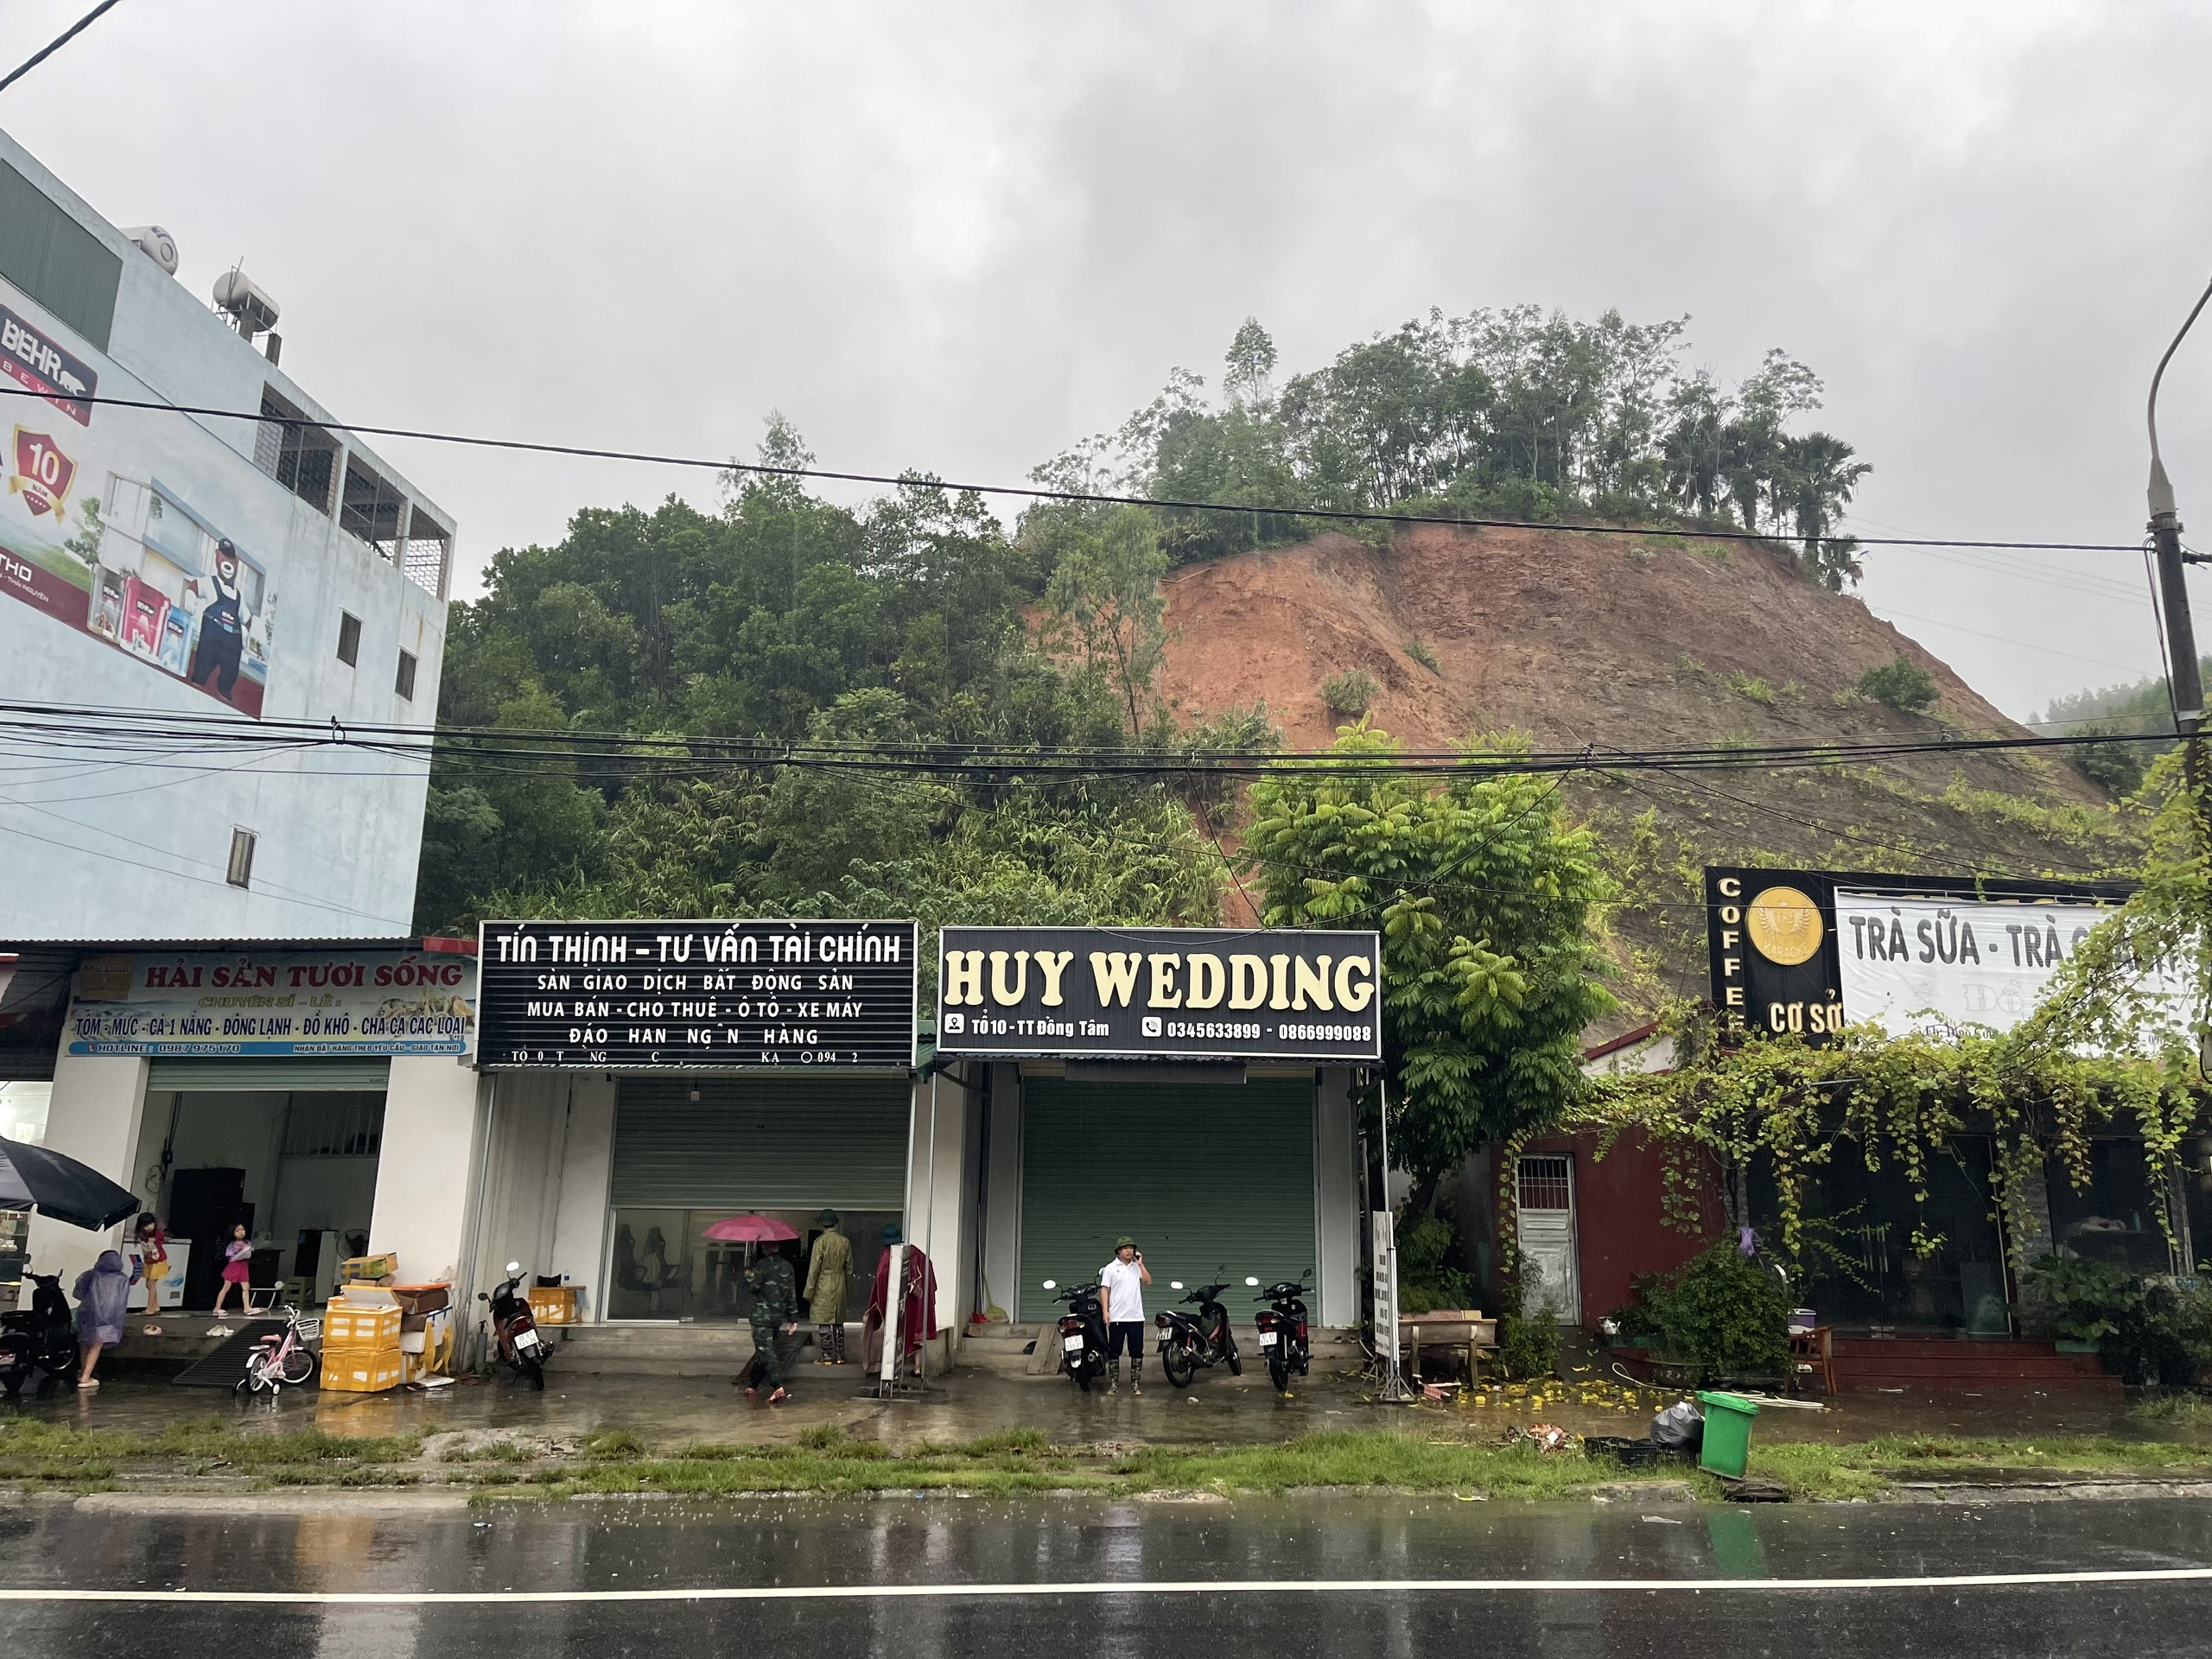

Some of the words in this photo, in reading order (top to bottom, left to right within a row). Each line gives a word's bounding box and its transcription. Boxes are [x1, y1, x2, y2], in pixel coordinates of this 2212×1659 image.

[1, 318, 61, 383] BEHR
[29, 442, 60, 486] 10
[497, 924, 537, 963] TÍN
[549, 931, 627, 967] THỊNH
[657, 934, 693, 963] TƯ
[703, 923, 758, 963] VẤN
[769, 923, 810, 963] TÀI
[819, 923, 900, 963] CHÍNH
[1764, 940, 1810, 958] KARAOKE
[1849, 906, 1910, 963] TRÀ
[1917, 908, 1980, 965] SỮA
[2005, 913, 2065, 969] TRÀ
[145, 957, 203, 988] HẢI
[212, 957, 278, 988] SẢN
[287, 962, 365, 987] TƯƠI
[374, 955, 463, 987] SỐNG
[537, 967, 570, 990] SÀN
[583, 968, 627, 990] GIAO
[643, 968, 687, 995] DỊCH
[703, 968, 735, 990] BẤT
[752, 968, 802, 995] ĐỘNG
[818, 967, 853, 990] SẢN
[944, 950, 1074, 1007] HUY
[1089, 951, 1376, 1012] WEDDING
[198, 995, 274, 1008] CHUYÊN
[527, 1001, 565, 1017] MUA
[575, 995, 609, 1017] BÁN
[626, 1002, 664, 1018] CHO
[671, 995, 717, 1018] THUÊ
[738, 995, 750, 1018] Ô
[757, 995, 779, 1018] TÔ
[798, 1002, 819, 1018] XE
[826, 995, 862, 1018] MÁY
[1768, 1000, 1803, 1034] CƠ
[1808, 988, 1843, 1034] SỞ
[76, 1014, 102, 1036] TÔM
[111, 1015, 138, 1039] MỰC
[149, 1014, 164, 1036] CÁ
[180, 1010, 213, 1036] NẮNG
[223, 1014, 257, 1036] ĐÔNG
[259, 1017, 291, 1039] LẠNH
[302, 1010, 321, 1035] ĐỒ
[324, 1014, 350, 1035] KHÔ
[361, 1010, 386, 1035] CHẢ
[390, 1013, 407, 1035] CÁ
[410, 1013, 433, 1035] CÁC
[569, 1021, 607, 1044] ĐÁO
[629, 1028, 666, 1044] HAN
[764, 1021, 818, 1044] HÀNG
[972, 1008, 989, 1034] TỔ
[990, 1020, 1007, 1034] 10
[1017, 1020, 1035, 1035] TT
[1037, 1015, 1074, 1037] Đồng
[1079, 1019, 1109, 1036] Tâm
[1167, 1021, 1261, 1039] 0345633899
[1279, 1024, 1372, 1041] 0866999088
[98, 1044, 146, 1053] HOTLINE
[159, 1044, 191, 1053] 0987
[193, 1044, 240, 1053] 975170
[410, 1044, 429, 1052] GIAO
